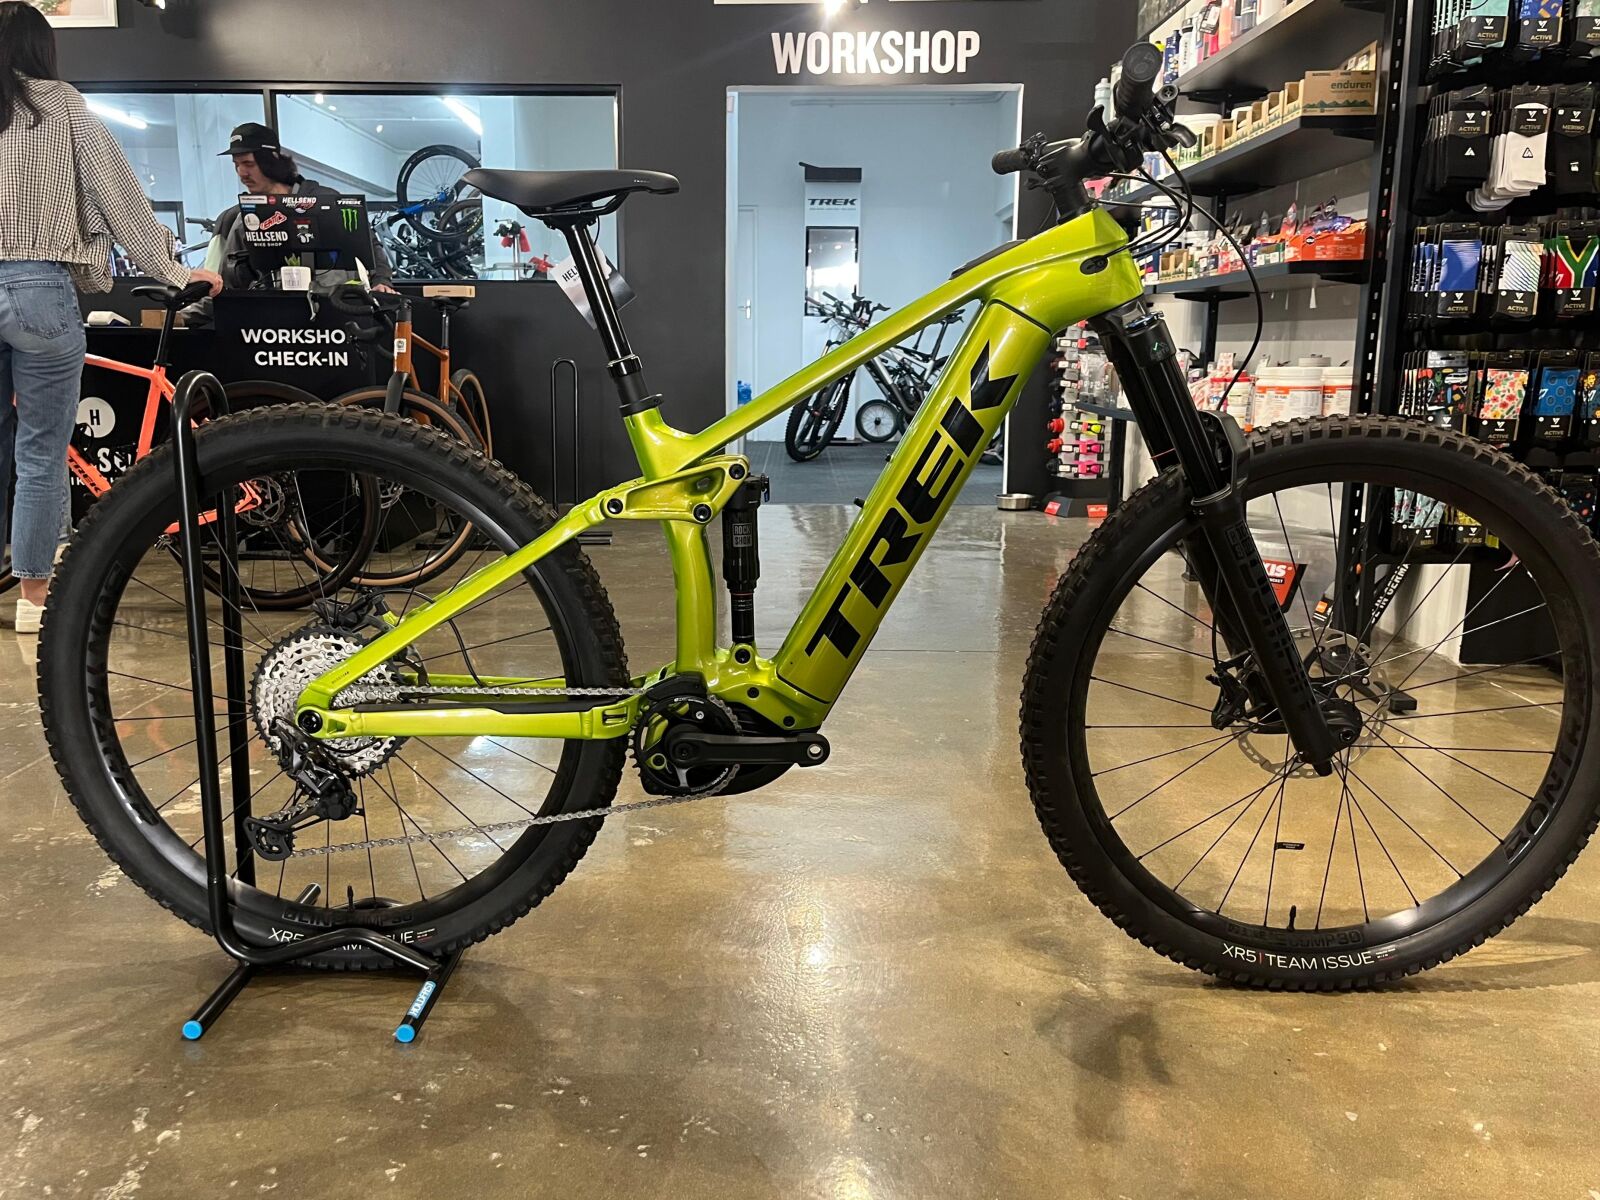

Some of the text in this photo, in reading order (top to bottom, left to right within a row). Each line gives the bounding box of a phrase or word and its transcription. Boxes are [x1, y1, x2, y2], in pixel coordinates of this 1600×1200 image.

[771, 30, 981, 75] WORKSHOP
[1330, 80, 1372, 89] enduren
[282, 196, 317, 204] HELLSEND
[807, 198, 858, 206] TREK
[245, 231, 289, 242] HELLSEND
[240, 328, 346, 344] WORKSHO
[254, 350, 349, 367] CHECK-IN
[89, 409, 101, 426] H
[67, 455, 102, 493] TREK
[804, 339, 1020, 659] TREK
[734, 525, 751, 535] ROCK
[1384, 563, 1411, 596] GERMA
[1222, 943, 1257, 963] XR5
[1265, 953, 1318, 970] TEAM
[1322, 951, 1375, 970] ISSUE
